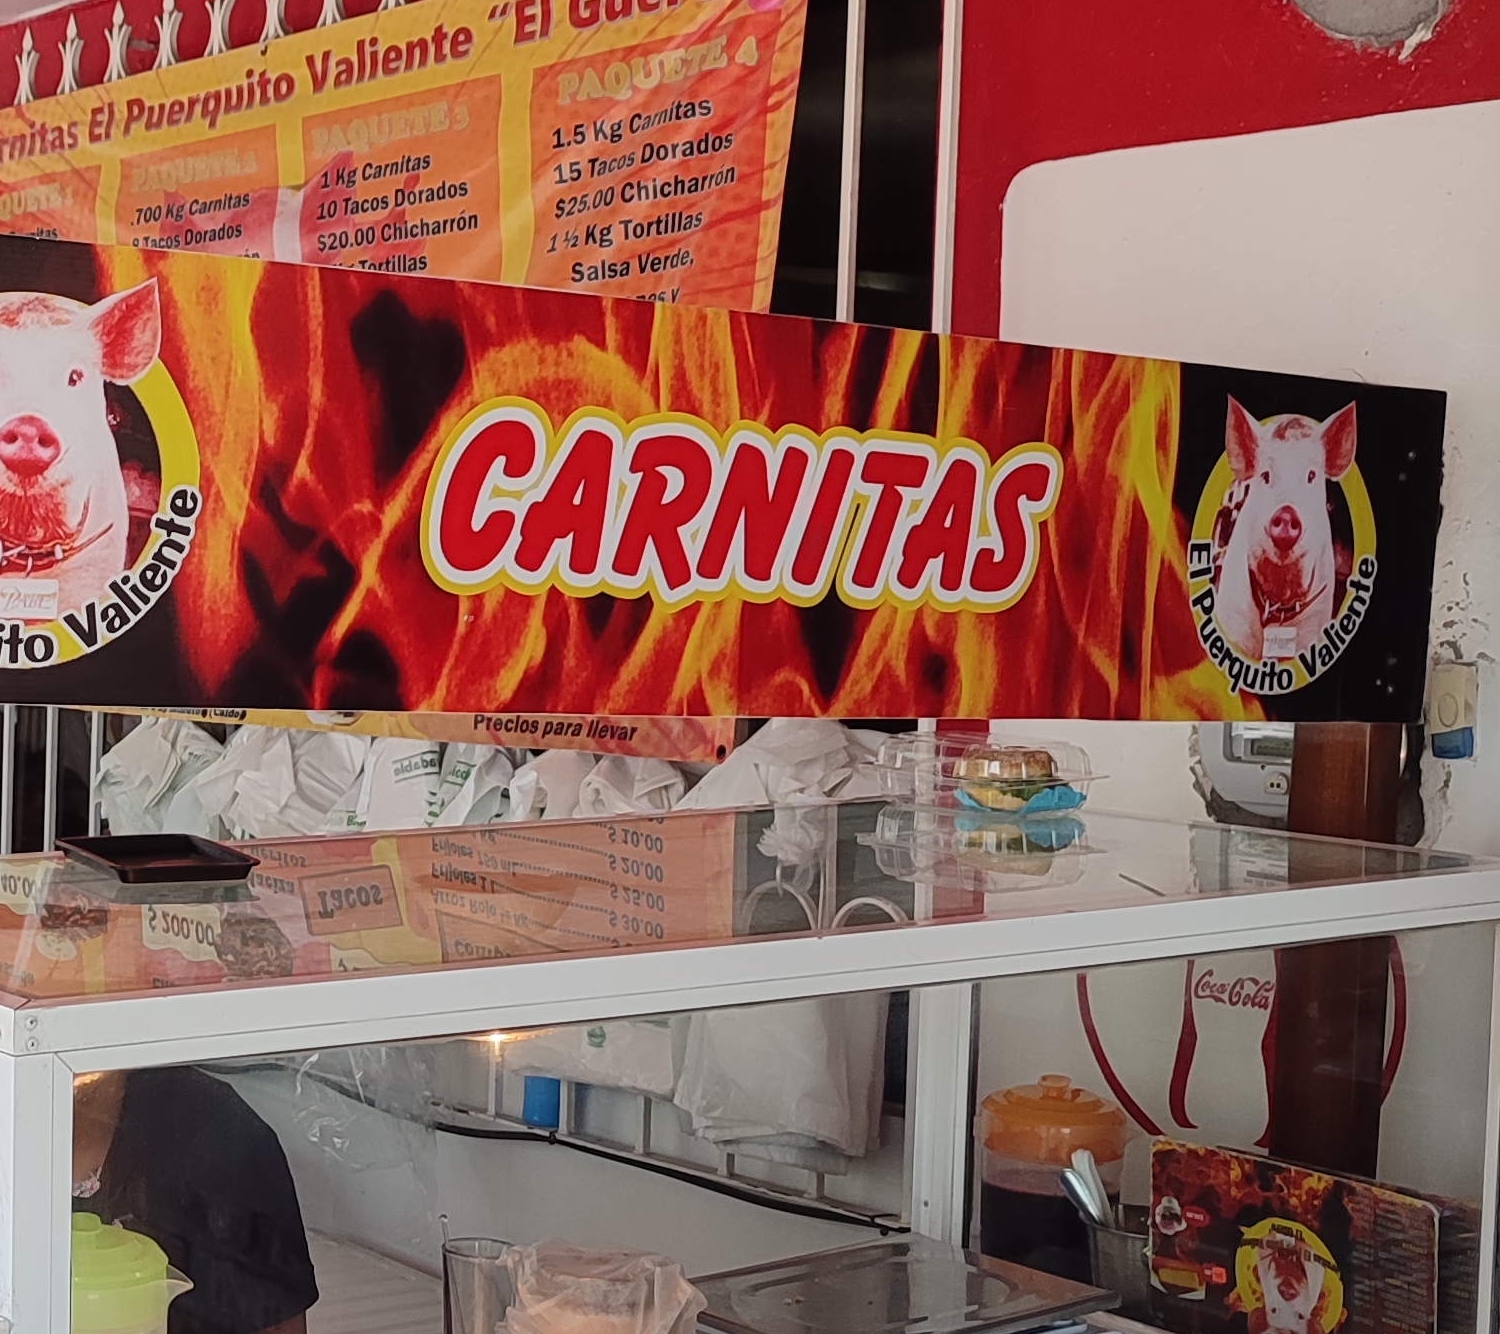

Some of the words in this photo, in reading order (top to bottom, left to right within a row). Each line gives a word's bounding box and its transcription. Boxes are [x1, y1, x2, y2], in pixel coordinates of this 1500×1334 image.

[88, 100, 116, 145] El
[122, 68, 297, 138] Puerquito
[305, 22, 474, 95] Valiente
[556, 34, 729, 105] PAQUETE
[734, 35, 760, 68] 4
[311, 100, 450, 157] PAQUETE
[454, 104, 471, 131] 3
[552, 123, 587, 150] 1.5
[592, 118, 624, 144] Kg
[629, 98, 713, 135] Carnitas
[320, 170, 331, 190] 1
[336, 166, 358, 189] Kg
[362, 154, 432, 182] Carnitas
[553, 161, 582, 185] 15
[588, 151, 636, 180] Tacos
[640, 131, 735, 165] Dorados
[130, 204, 162, 227] .700
[165, 203, 187, 223] Kg
[188, 192, 251, 217] Carnitas
[316, 199, 338, 221] 10
[343, 195, 390, 217] Tacos
[394, 180, 469, 208] Dorados
[554, 186, 615, 221] $25.00
[621, 164, 736, 205] Chicharrón
[143, 234, 181, 250] Tacos
[184, 222, 243, 247] Dorados
[317, 226, 376, 253] $20.00
[381, 210, 479, 243] Chicharrón
[585, 223, 614, 249] Kg
[619, 210, 704, 242] Tortillas
[570, 259, 632, 284] Salsa
[430, 408, 1058, 604] CARNITAS
[63, 487, 199, 649] Valiente
[1189, 542, 1213, 580] El
[1191, 587, 1294, 693] Puerquito
[1298, 556, 1376, 679] Valiente
[473, 714, 539, 734] Precios
[541, 720, 583, 739] para
[586, 719, 639, 742] llevar
[1194, 968, 1275, 1011] Coca-Cola
